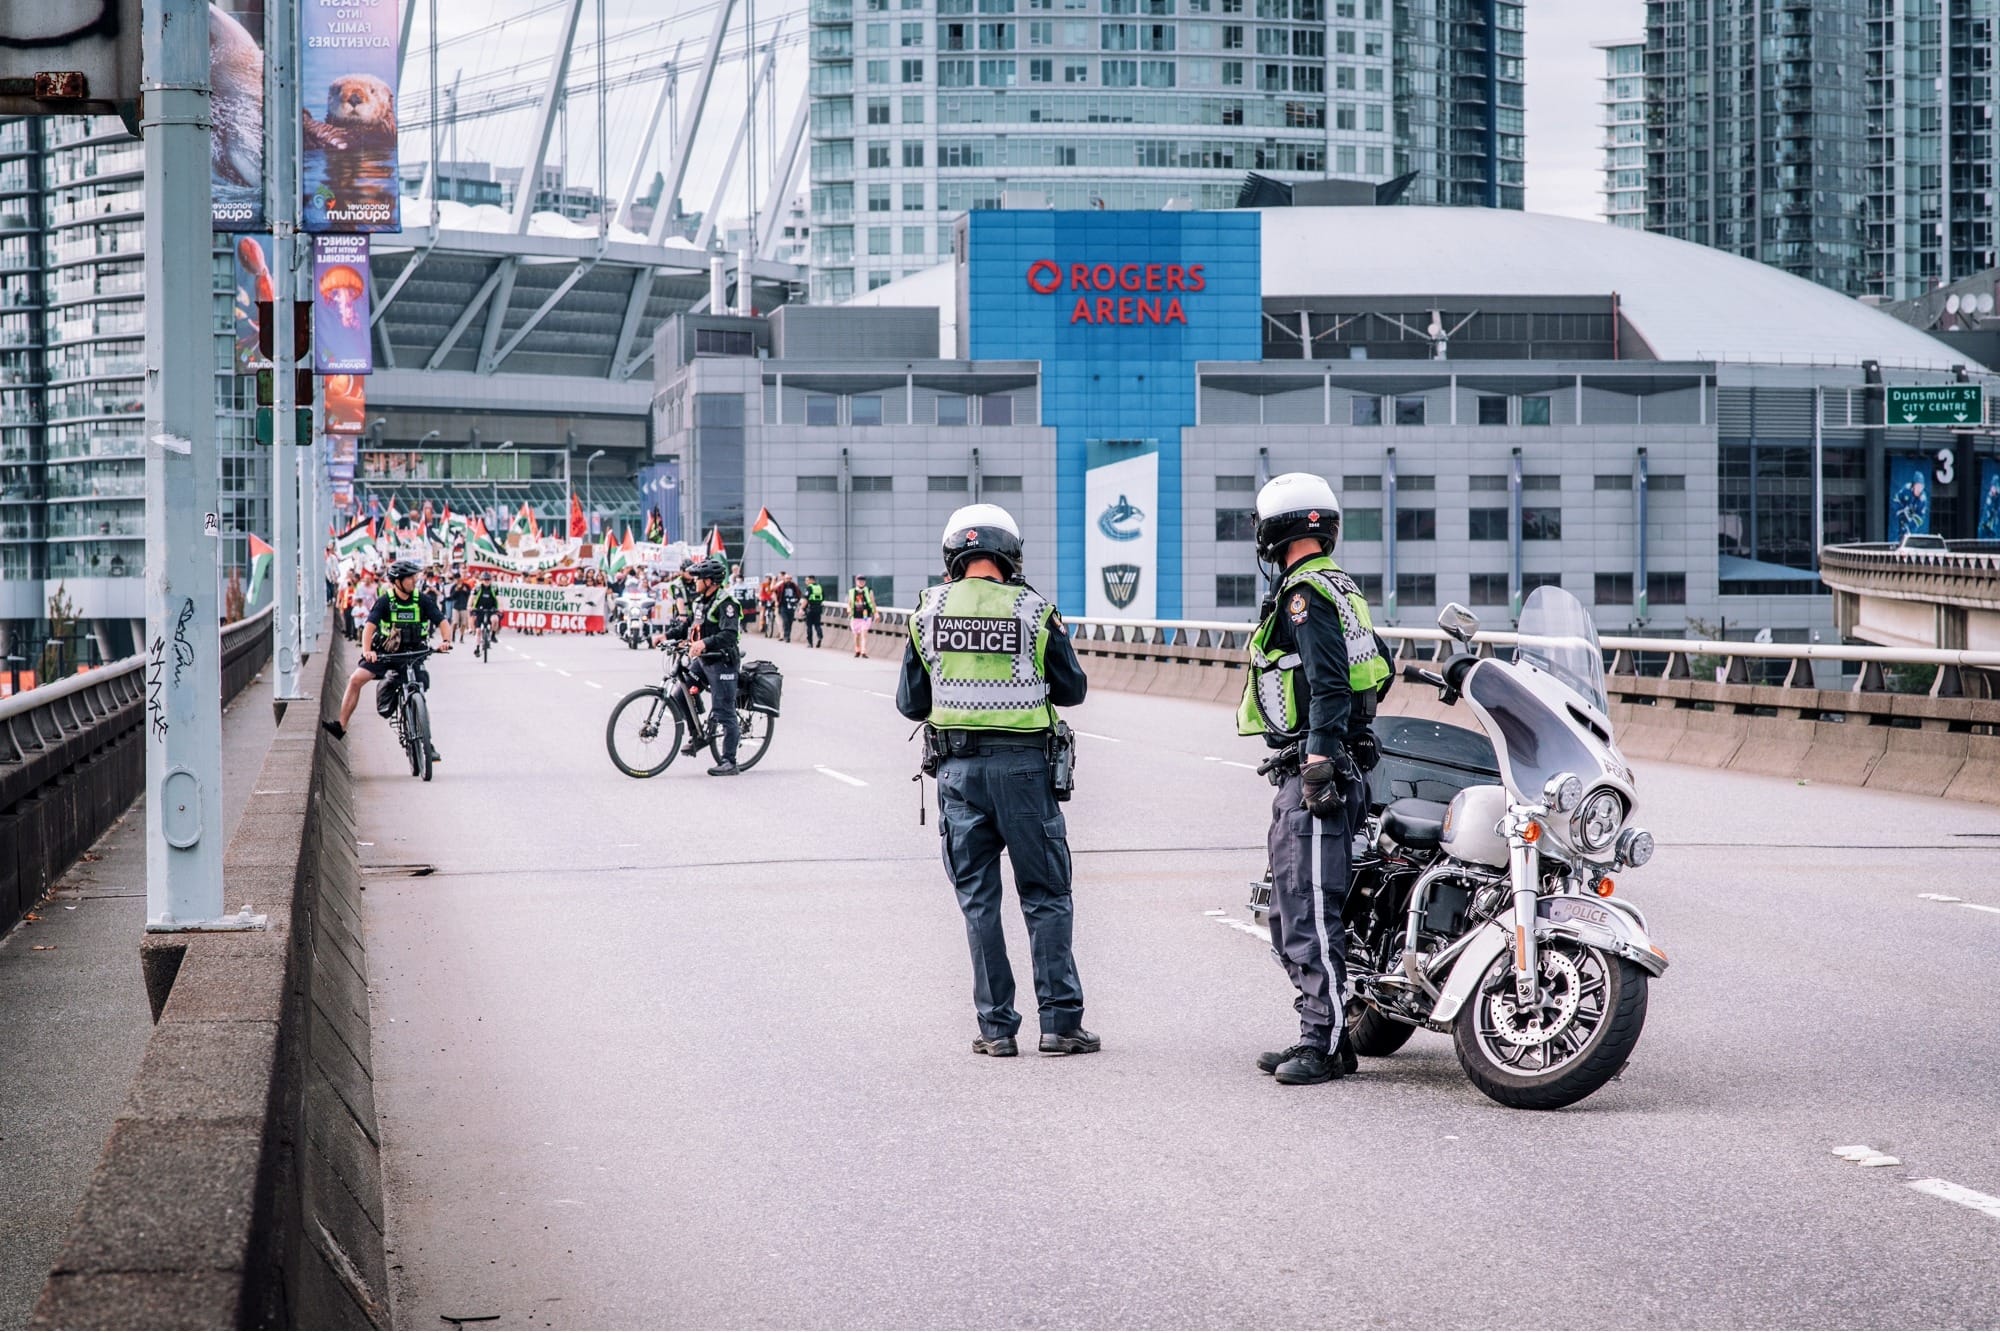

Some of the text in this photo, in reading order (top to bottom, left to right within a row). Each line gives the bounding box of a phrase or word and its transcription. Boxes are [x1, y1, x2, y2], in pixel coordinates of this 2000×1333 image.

[1071, 263, 1206, 292] ROGERS
[1071, 297, 1188, 324] ARENA
[1893, 389, 1976, 400] Dunsmuir St
[1902, 402, 1967, 411] CITY CENTRE
[1936, 448, 1955, 484] 3
[474, 550, 517, 571] STATUS
[500, 587, 565, 600] INDIGENOUS
[509, 599, 582, 612] SOVEREIGNTY
[508, 612, 587, 630] LAND BACK
[938, 619, 1016, 632] VANCOUVER
[936, 630, 1017, 652] POLICE
[1564, 903, 1608, 923] POLICE
